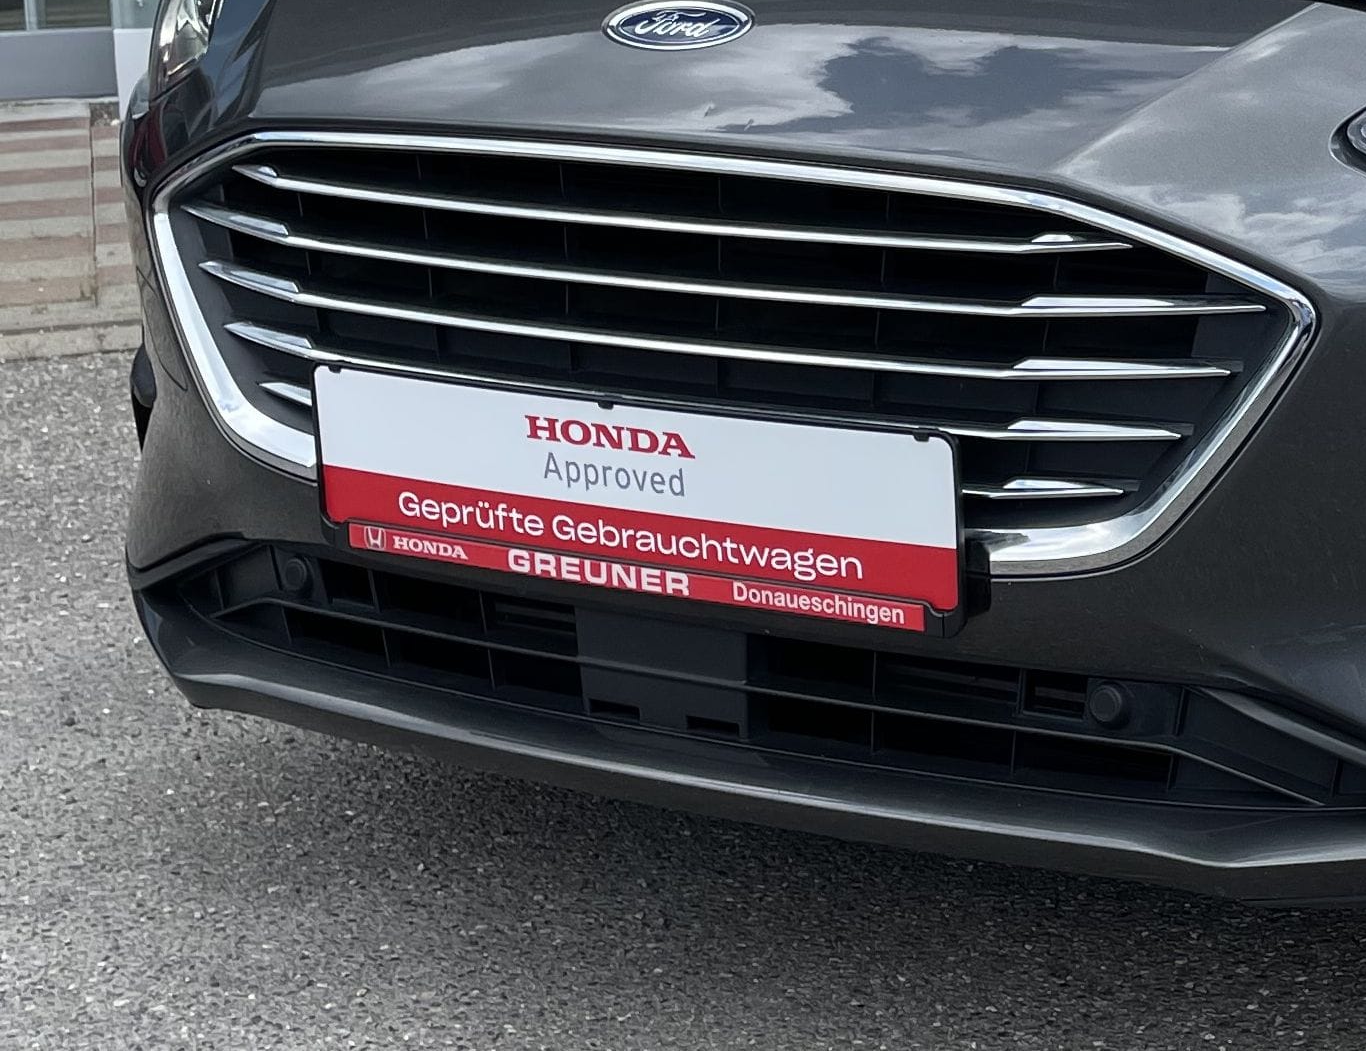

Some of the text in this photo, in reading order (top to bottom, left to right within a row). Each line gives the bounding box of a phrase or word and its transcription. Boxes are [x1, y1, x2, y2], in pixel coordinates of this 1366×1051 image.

[634, 10, 721, 38] Ford
[524, 414, 696, 459] HONDA
[544, 451, 685, 497] Approved
[398, 491, 863, 581] Geprüfte Gebrauchtwagen
[392, 535, 469, 560] HONDA
[507, 549, 690, 596] GREUNER
[732, 581, 905, 625] Donaueschingen
